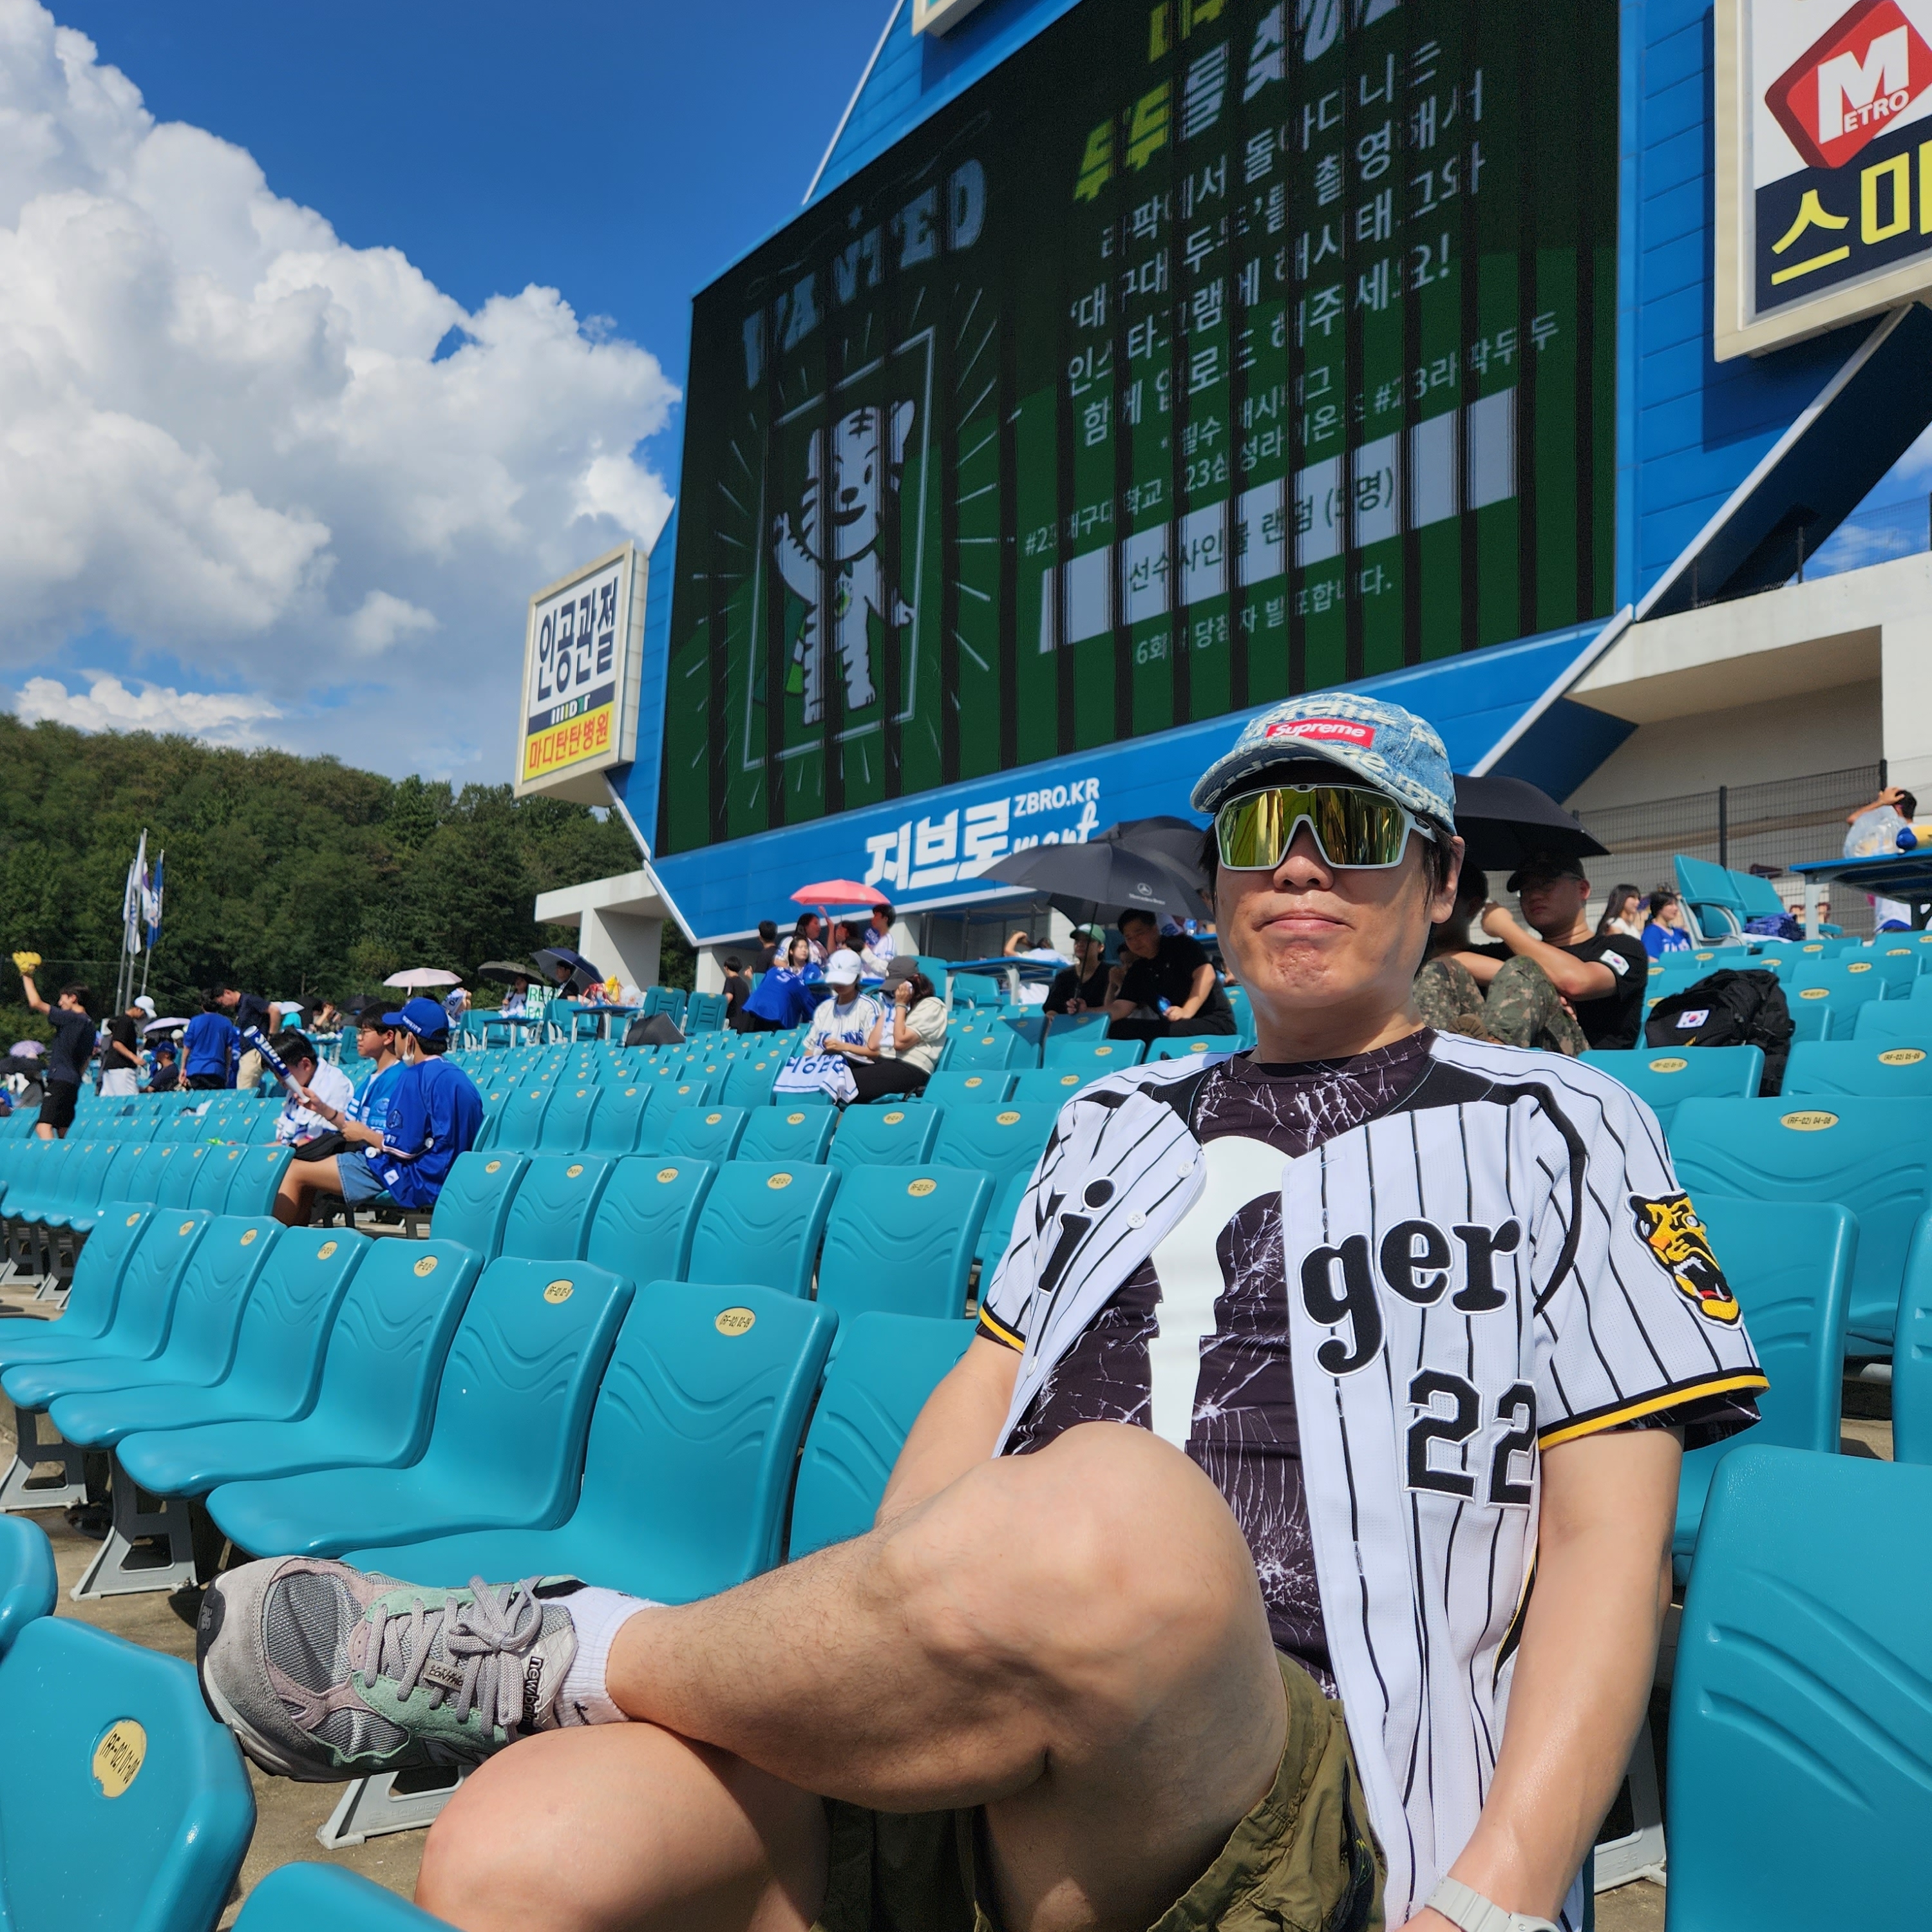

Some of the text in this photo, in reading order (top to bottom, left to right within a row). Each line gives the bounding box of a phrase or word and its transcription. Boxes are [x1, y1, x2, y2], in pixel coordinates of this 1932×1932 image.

[1074, 41, 1227, 204] 두두를
[1817, 25, 1909, 144] METRO
[537, 576, 619, 703] 인공관절
[528, 710, 610, 770] 마디탄탄병원
[1272, 723, 1366, 738] Supreme
[1014, 777, 1100, 818] ZBRO.KR
[864, 797, 1011, 891] 지브로
[1786, 1116, 1812, 1125] (RF-02)
[1299, 1215, 1525, 1378] ger
[1402, 1365, 1539, 1510] 22
[429, 1669, 464, 1687] CONTRO
[99, 1728, 131, 1772] (RF-02)
